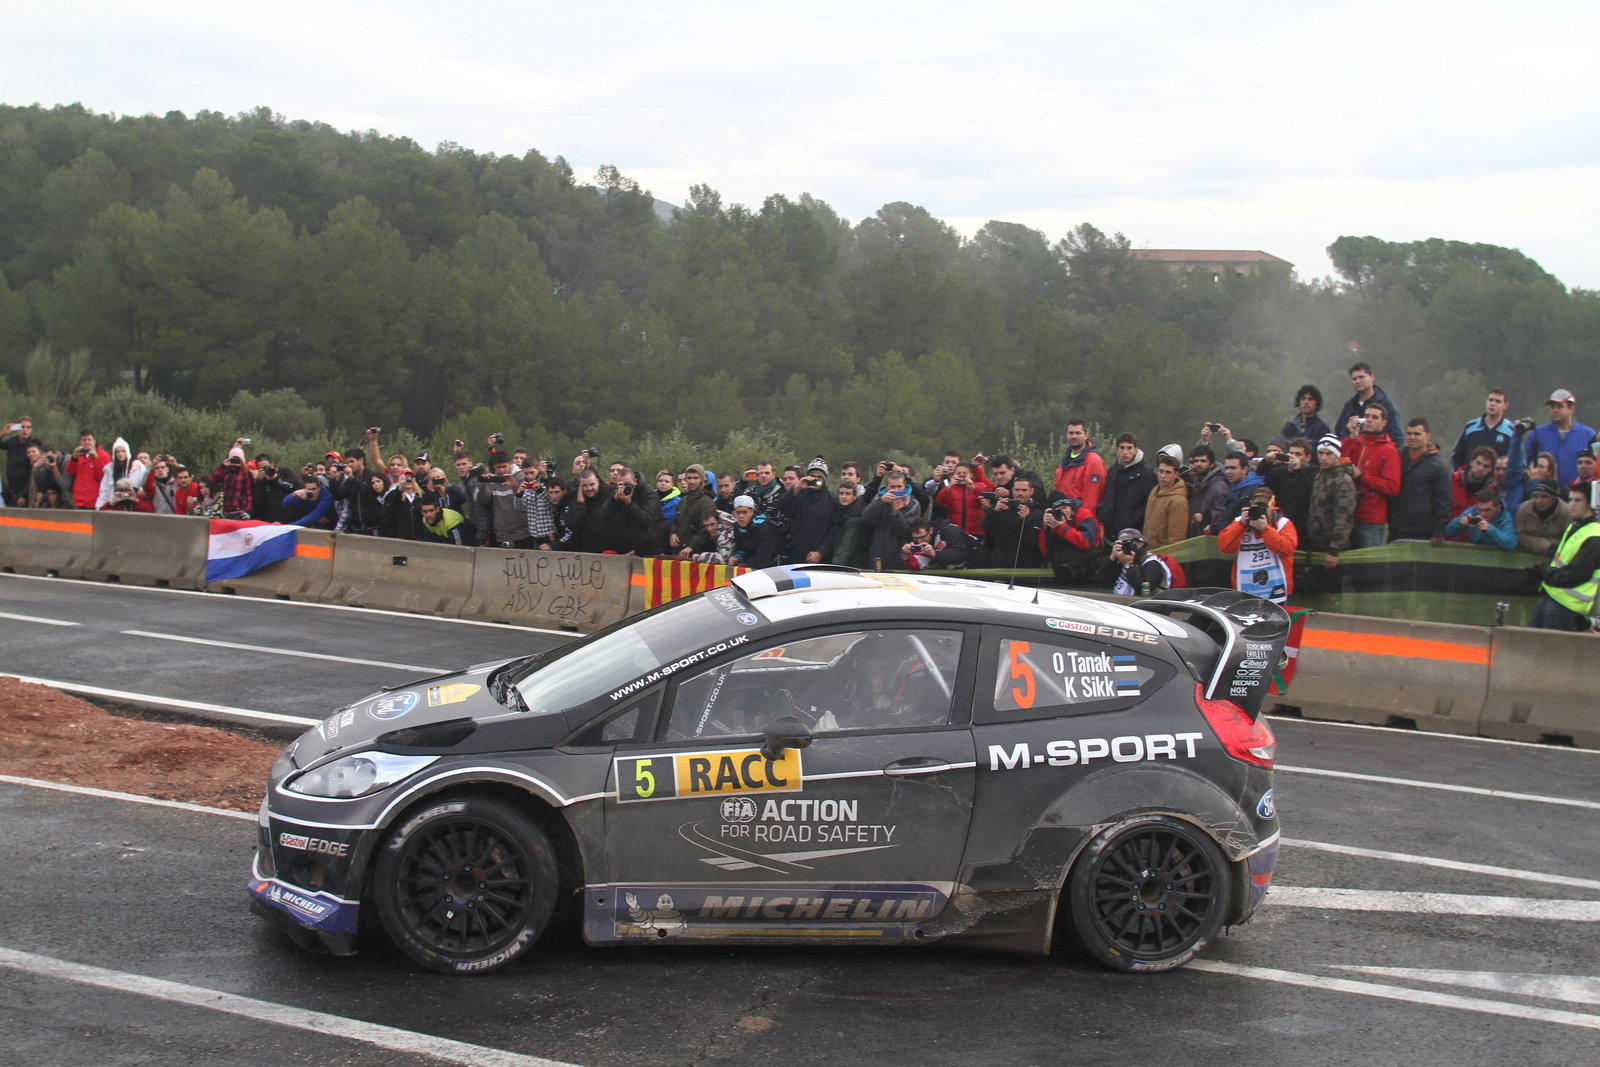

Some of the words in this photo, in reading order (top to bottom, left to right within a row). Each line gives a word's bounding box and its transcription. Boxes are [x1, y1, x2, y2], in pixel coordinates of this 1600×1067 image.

[1252, 550, 1271, 562] 292
[1058, 620, 1093, 633] Castrol
[1096, 626, 1159, 645] EDGE
[1052, 652, 1065, 674] O
[1067, 651, 1112, 673] Tanak
[1009, 641, 1036, 709] 5
[1064, 677, 1077, 698] K
[1081, 675, 1115, 697] Sikk
[1230, 686, 1248, 694] NGK
[988, 732, 1203, 771] M-SPORT
[635, 758, 656, 798] 5
[688, 752, 788, 793] RACC
[760, 799, 858, 822] ACTION
[721, 825, 750, 838] FOR
[755, 825, 811, 842] ROAD
[817, 825, 896, 842] SAFETY
[308, 838, 351, 857] EDGE
[282, 891, 326, 914] MICHELIN
[699, 895, 931, 919] MICHELIN
[456, 941, 521, 970] MICHELIN
